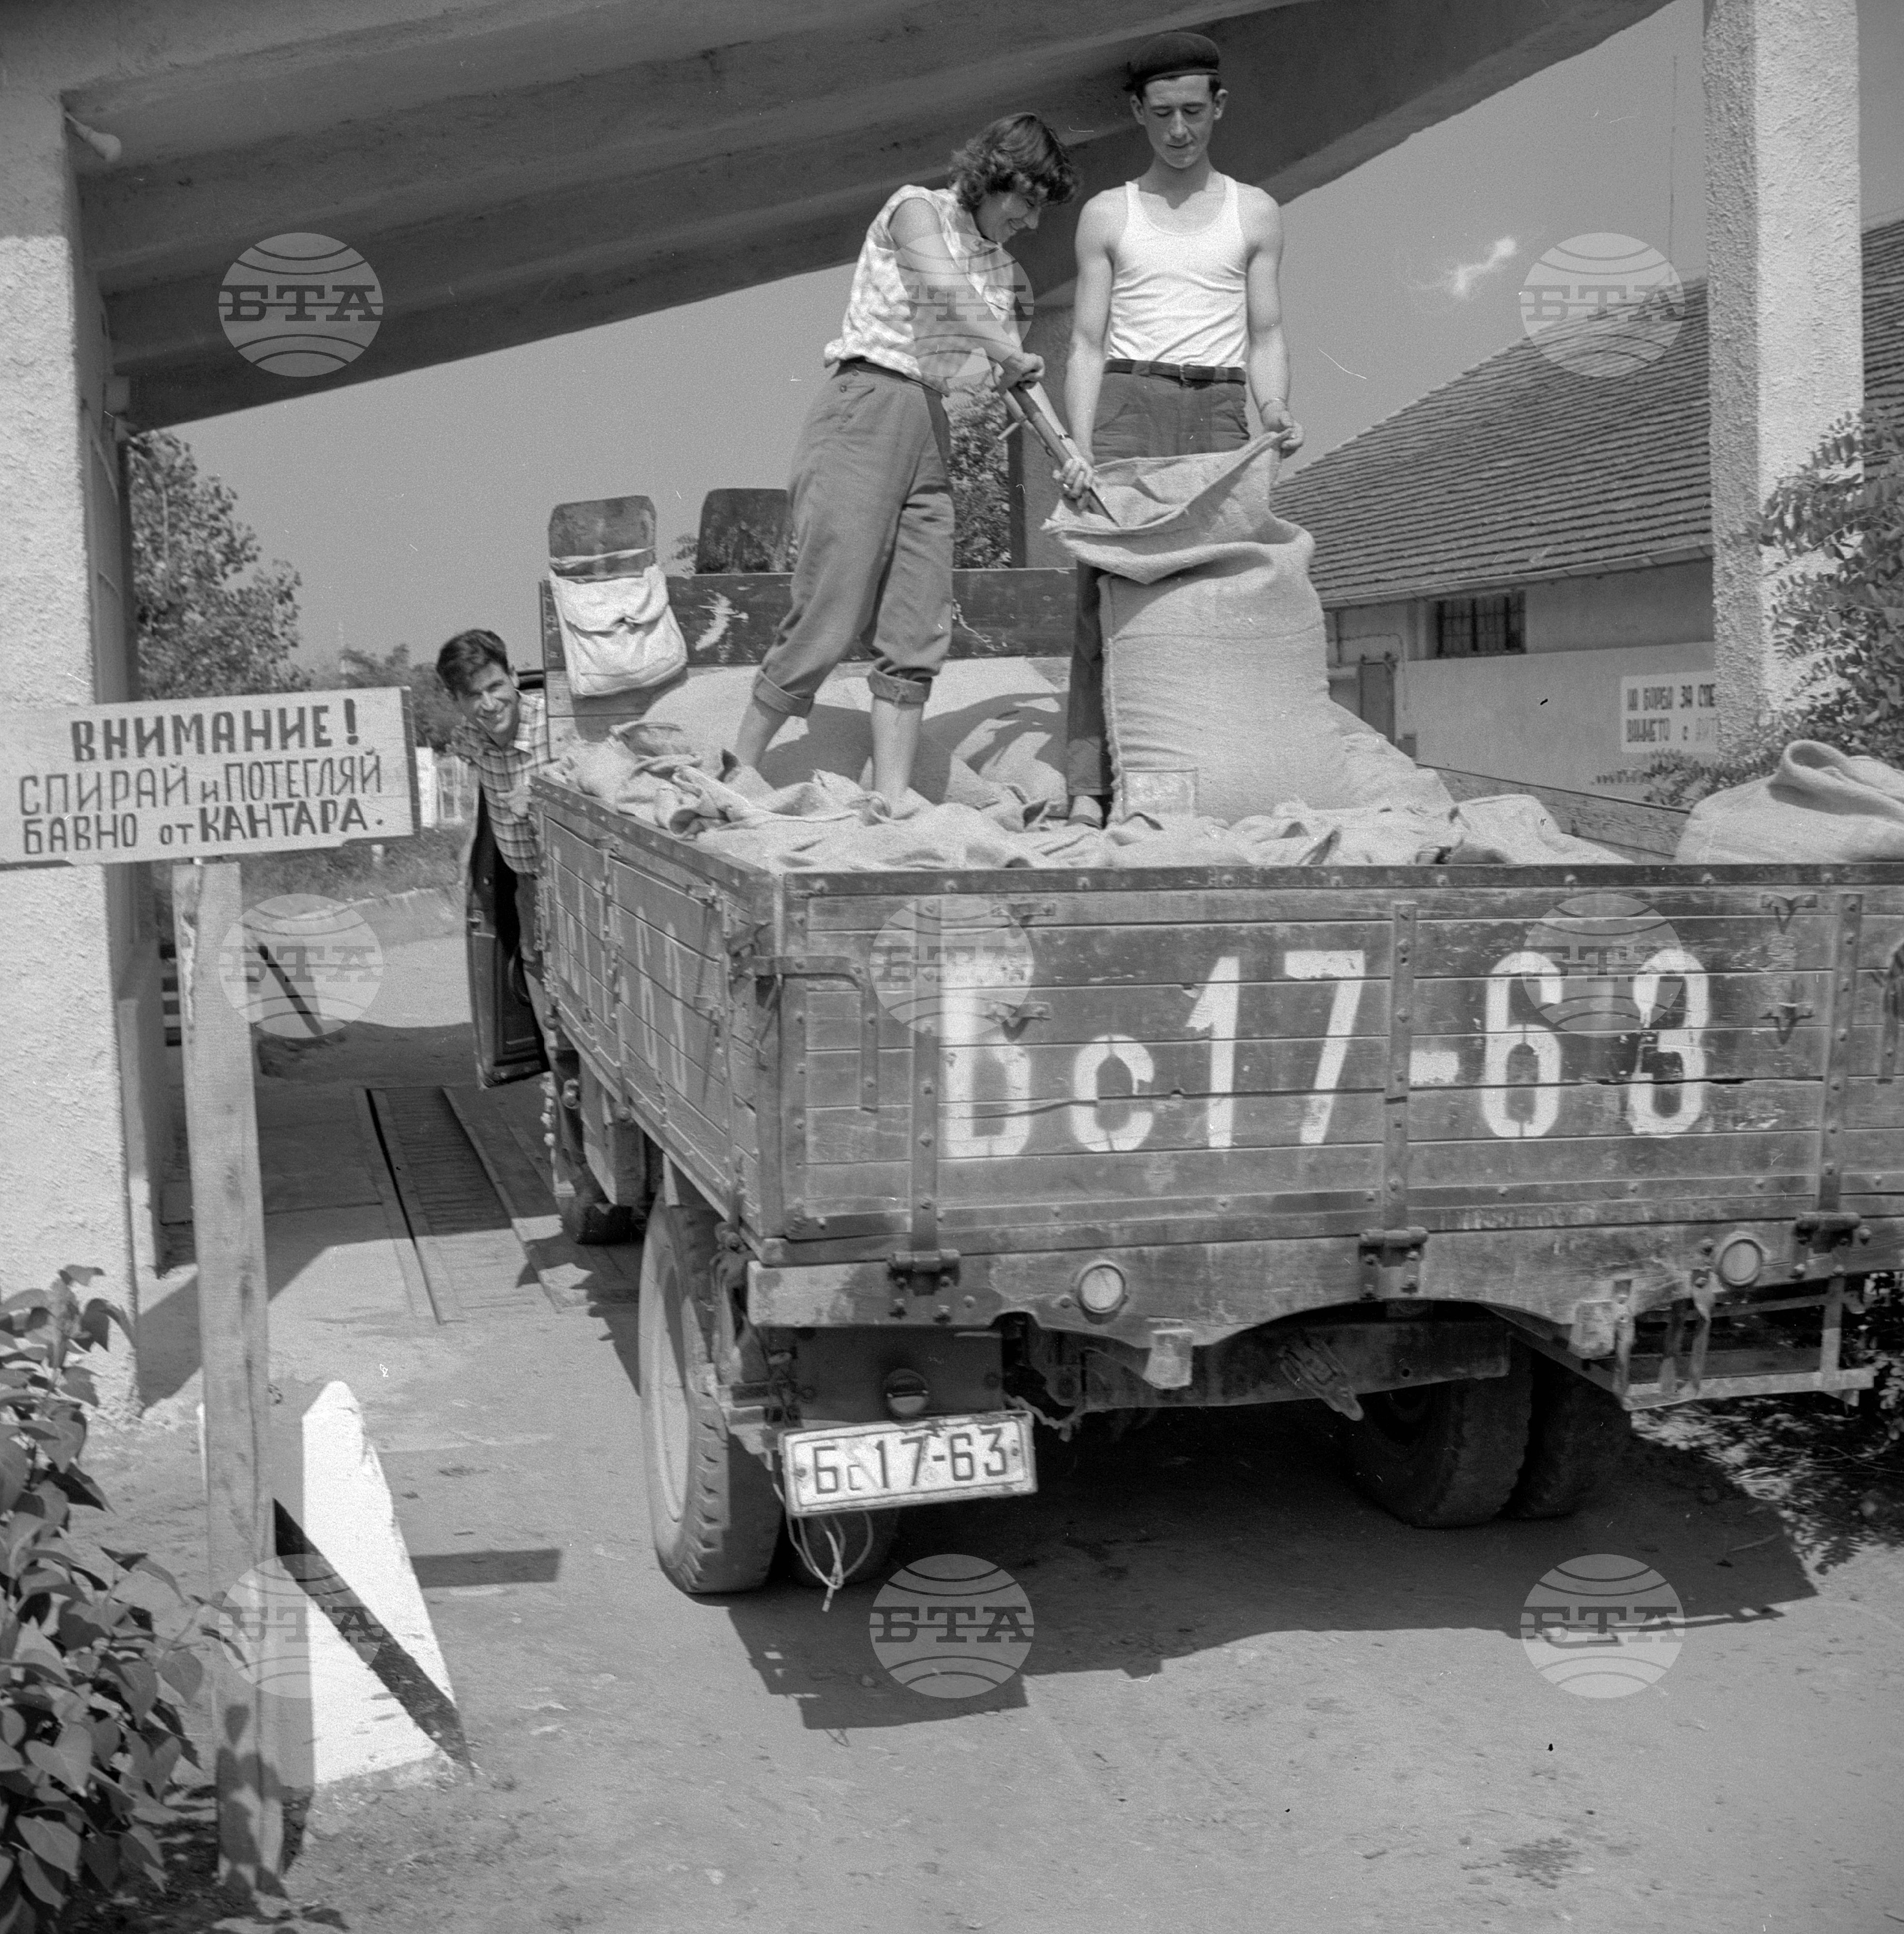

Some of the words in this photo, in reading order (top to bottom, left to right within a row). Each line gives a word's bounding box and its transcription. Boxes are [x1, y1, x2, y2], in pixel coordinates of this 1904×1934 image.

[1681, 685, 1693, 708] ЗА
[71, 699, 359, 762] ВНИМАНИЕ!
[19, 763, 189, 816] СПИРАЙ
[224, 746, 382, 803] ПОТЕГЛЯЙ
[23, 812, 138, 855] БАВНО
[198, 797, 384, 842] КАНТАРА.
